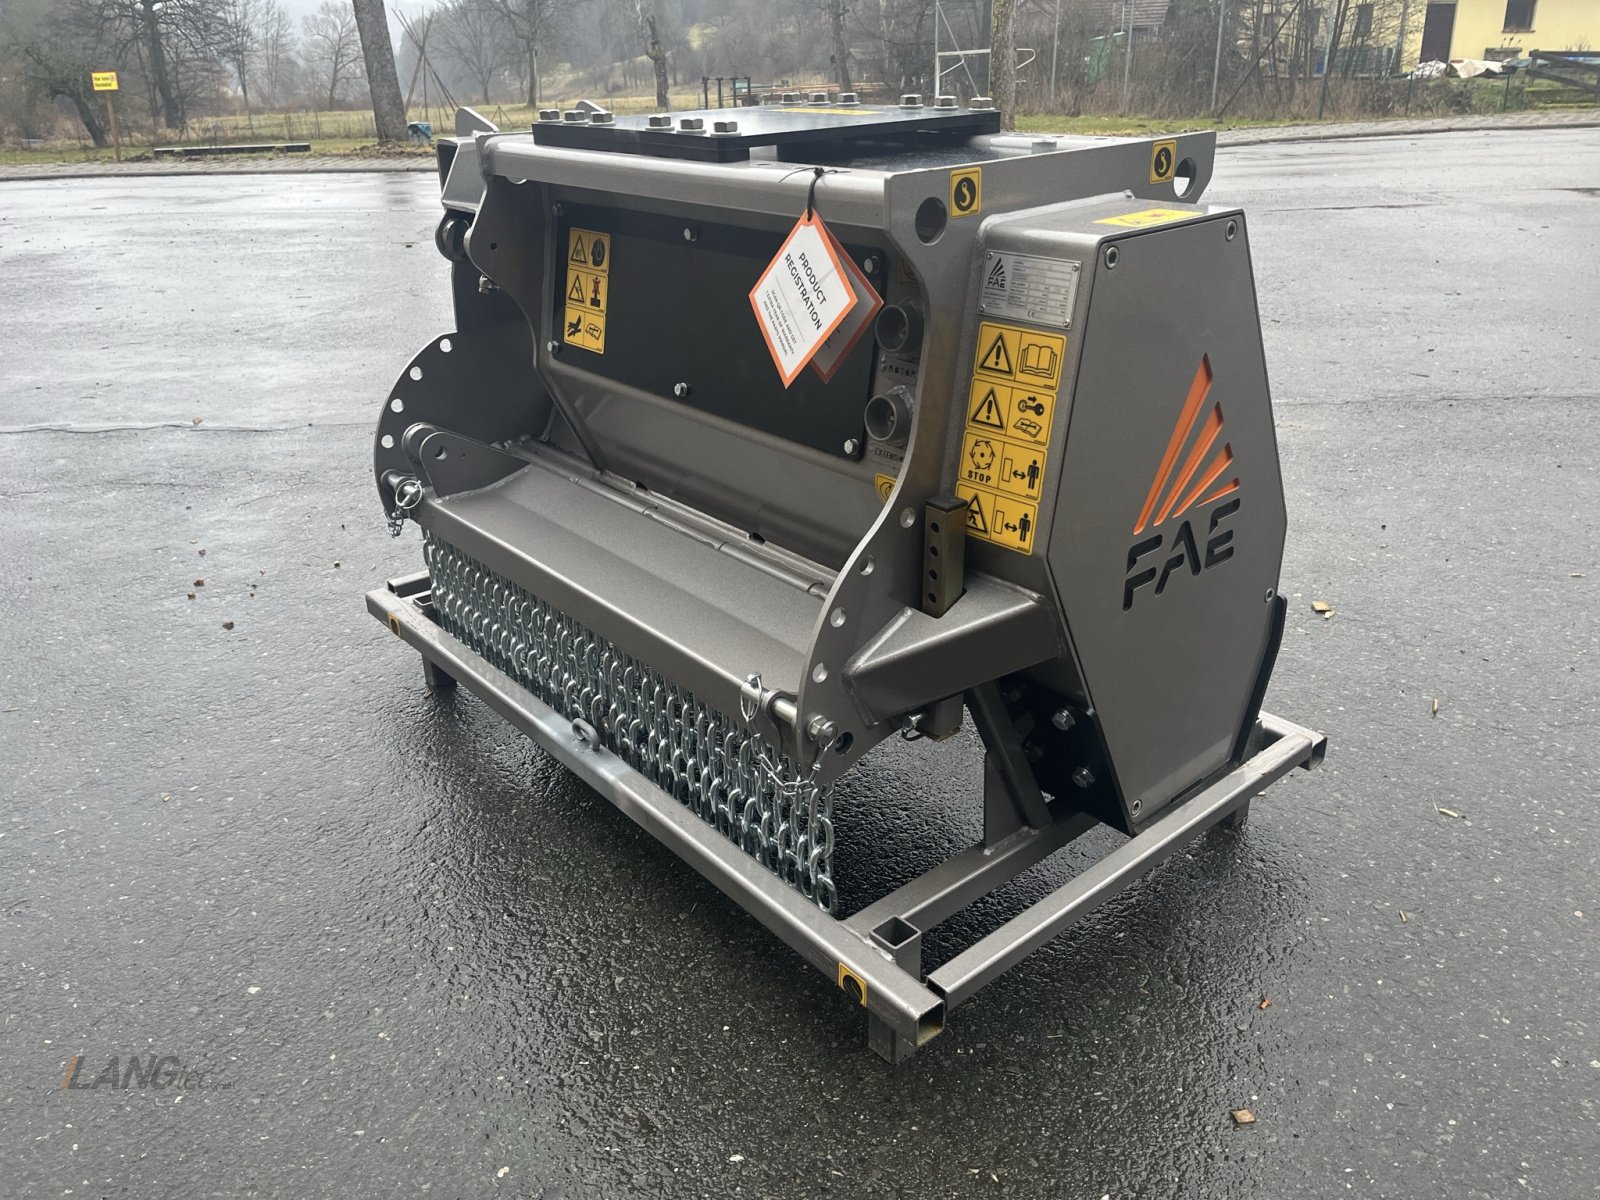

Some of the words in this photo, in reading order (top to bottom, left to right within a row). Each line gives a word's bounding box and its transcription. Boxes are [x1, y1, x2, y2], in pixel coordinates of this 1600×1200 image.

[785, 253, 822, 331] REGISTRATION
[798, 252, 827, 305] PRODUCT
[987, 276, 1007, 289] FAE
[967, 470, 992, 484] STOP
[1122, 498, 1241, 613] FAE
